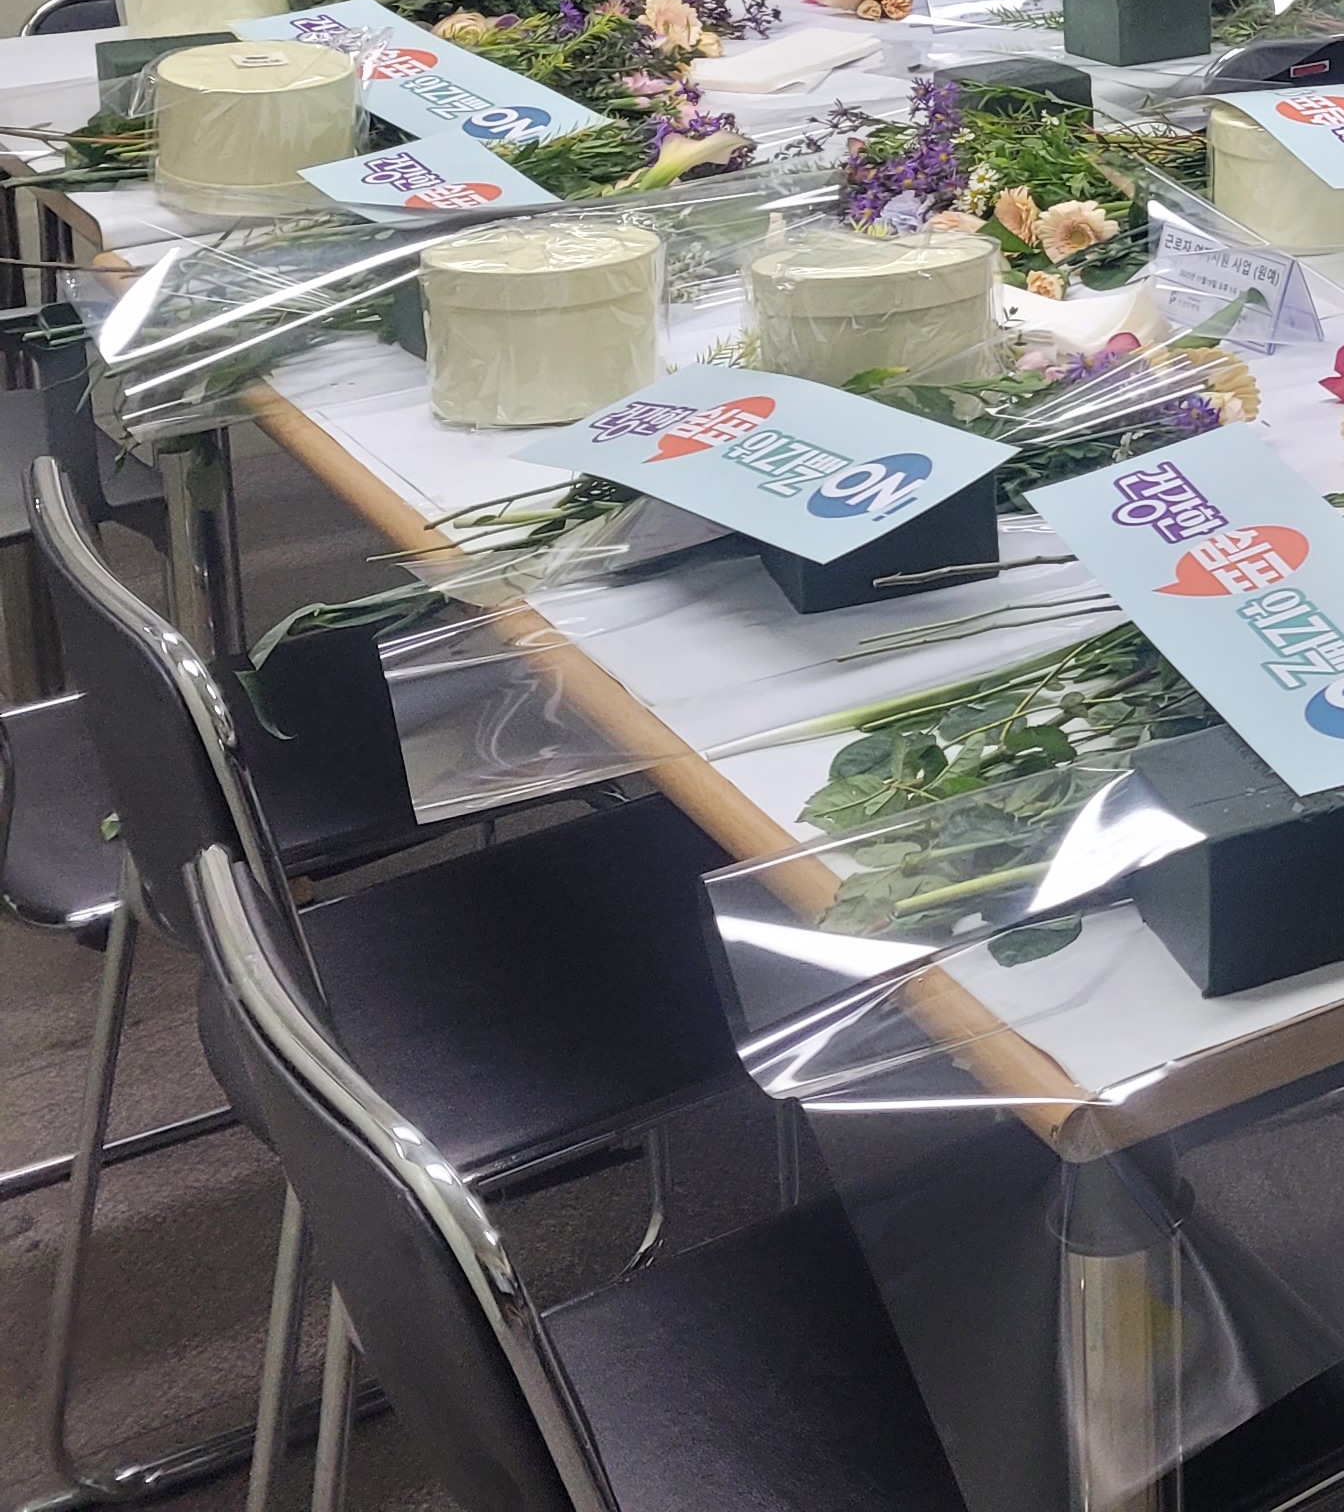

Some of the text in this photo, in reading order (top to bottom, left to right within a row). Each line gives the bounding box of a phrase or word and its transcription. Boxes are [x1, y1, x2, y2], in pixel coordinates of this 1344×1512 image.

[401, 74, 495, 120] 워라밸
[363, 152, 446, 191] 건강한
[1164, 233, 1192, 253] 근로자
[1232, 257, 1252, 276] 사업
[1253, 265, 1280, 287] (원예)
[590, 401, 926, 522] 건강한 쉼표 워라밸 ON!
[1111, 461, 1230, 545] 건강한
[1190, 525, 1294, 594] 쉼표
